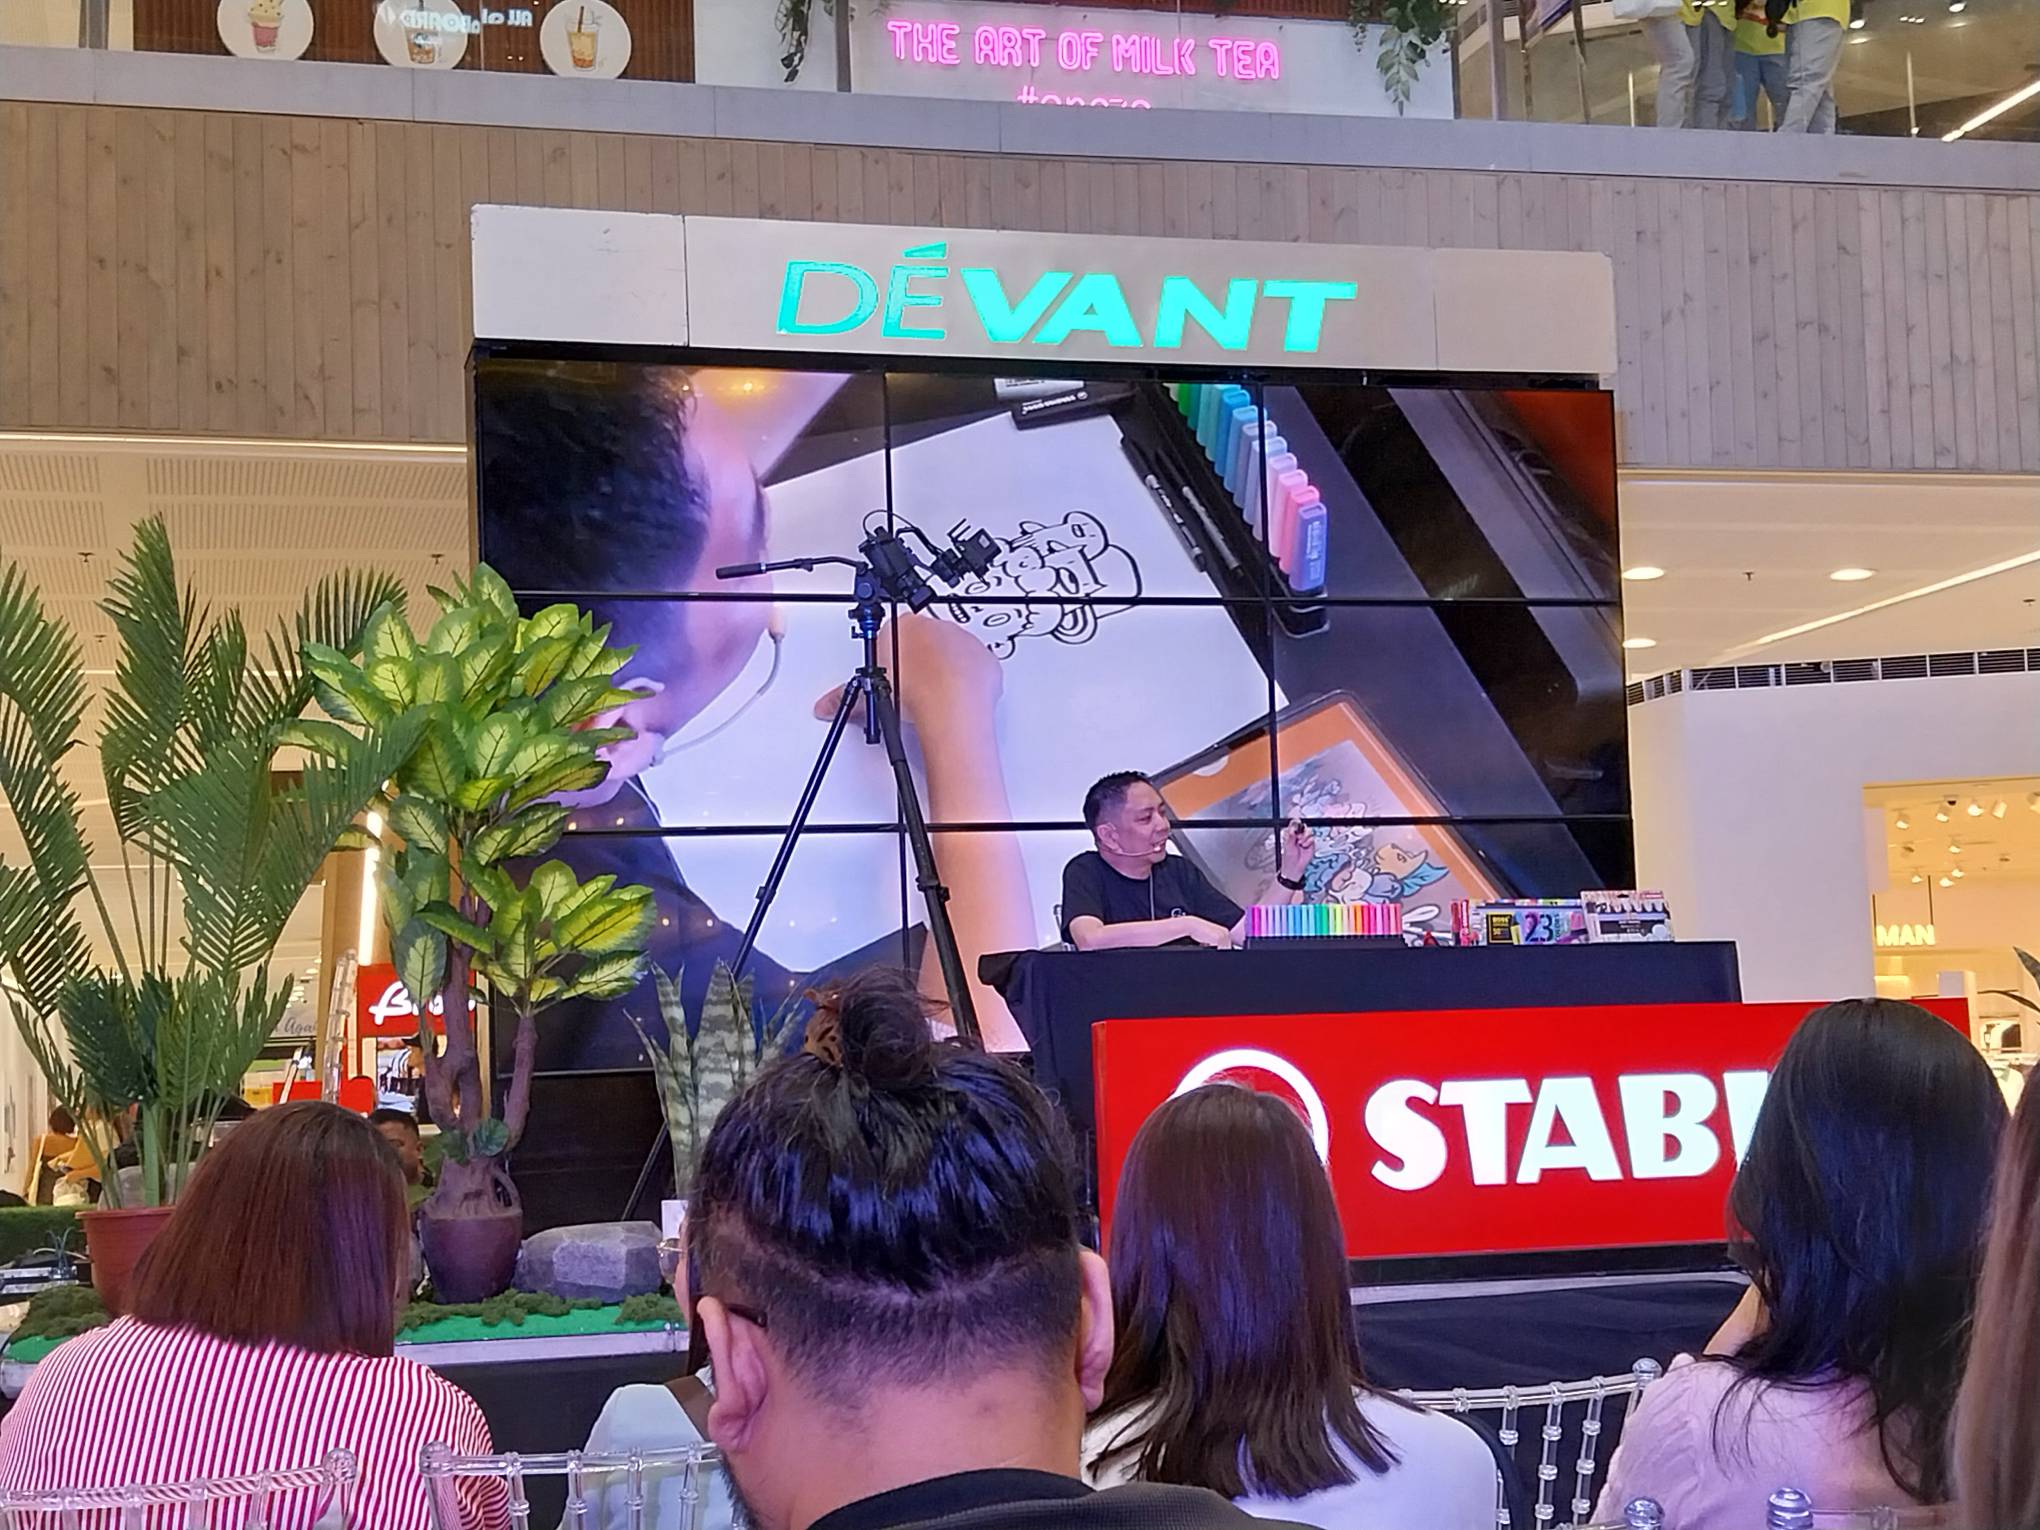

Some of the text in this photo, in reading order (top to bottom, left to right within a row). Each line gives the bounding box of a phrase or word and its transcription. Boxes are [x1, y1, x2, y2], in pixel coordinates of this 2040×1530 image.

[887, 20, 1281, 80] THE ART OF MILK TEA
[776, 240, 1358, 353] DÉVANT
[1875, 924, 1936, 946] MAN
[1364, 1071, 1770, 1192] STABI
